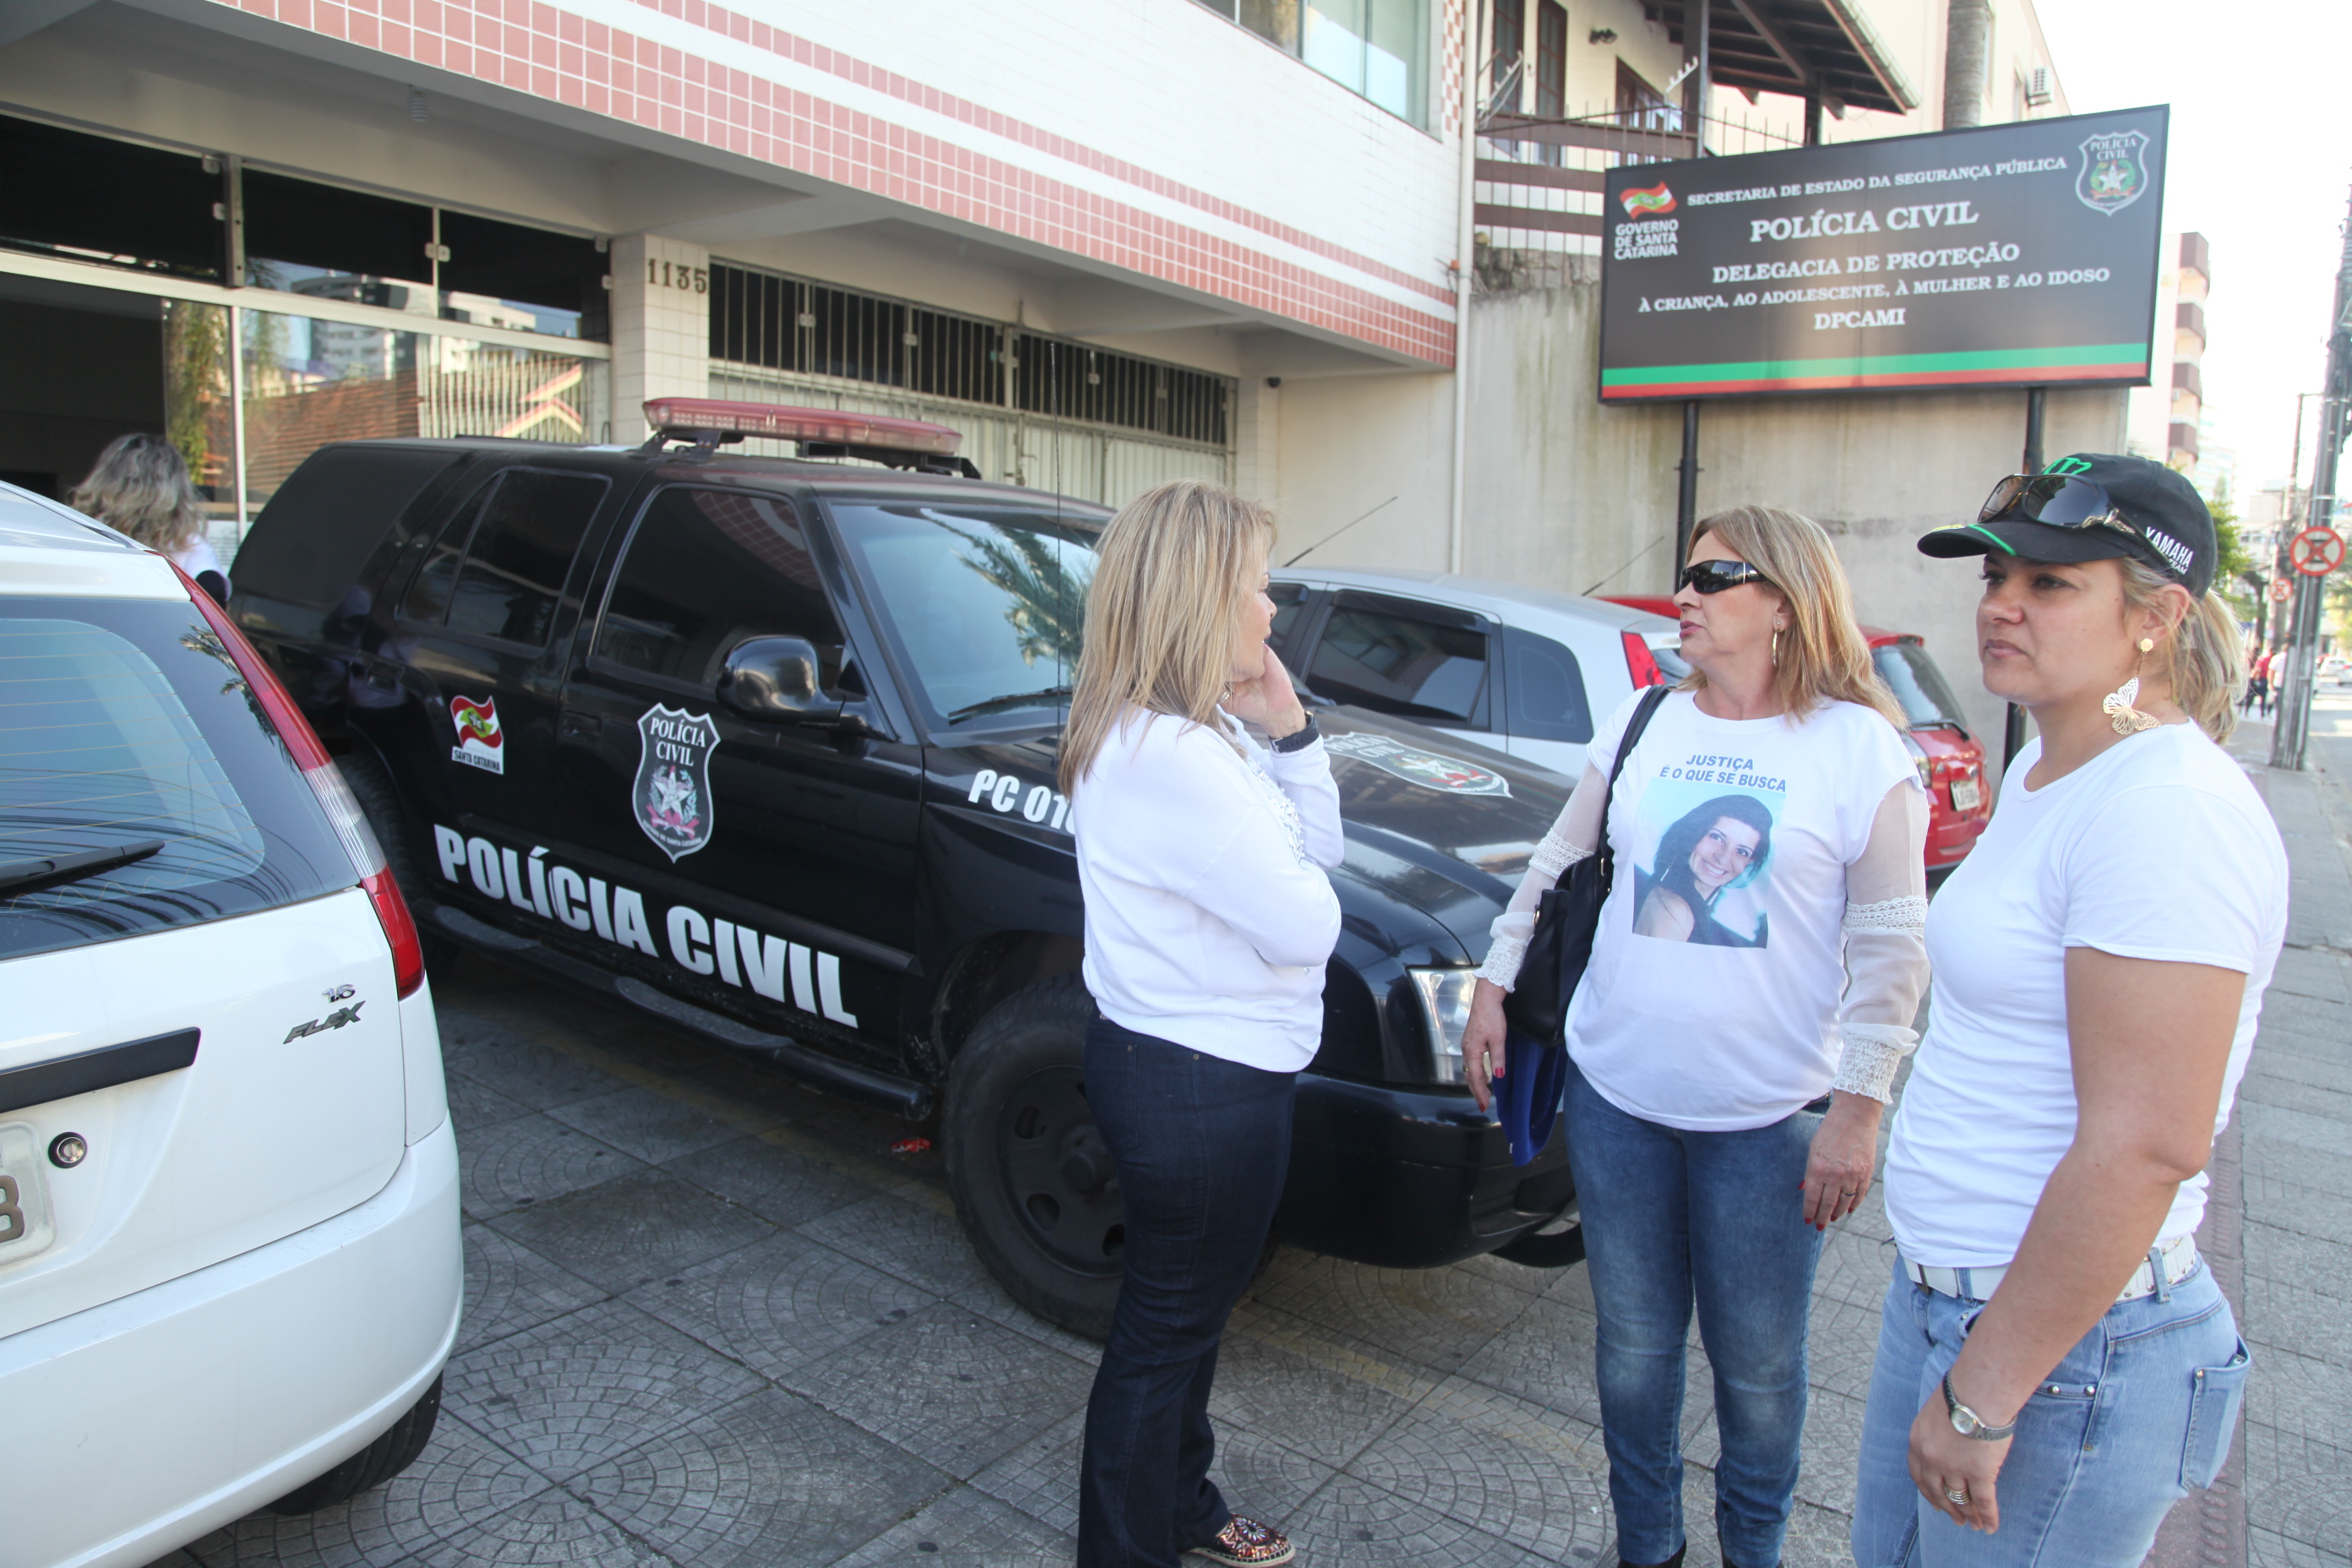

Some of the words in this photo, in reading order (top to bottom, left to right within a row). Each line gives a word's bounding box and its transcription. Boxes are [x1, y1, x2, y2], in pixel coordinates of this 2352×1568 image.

[2096, 149, 2128, 161] CIVIL
[1687, 187, 1777, 205] SECRETARIA
[1781, 184, 1801, 197] DE
[1805, 177, 1865, 194] ESTADO
[1868, 176, 1891, 188] DA
[1894, 165, 1991, 186] SEGURANÇA
[1995, 157, 2067, 176] PÚBLICA
[1615, 219, 1679, 236] GOVERNO
[1750, 209, 1880, 242] POLÍCIA
[1886, 201, 1979, 231] CIVIL
[1614, 236, 1633, 248] DE
[1635, 231, 1678, 247] SANTA
[1614, 243, 1678, 260] CATARINA
[648, 258, 707, 294] 1135
[1712, 259, 1841, 283] DELEGACIA
[1846, 255, 1880, 274] DE
[1886, 242, 2020, 270] PROTEÇÃO
[1638, 297, 1651, 313] À
[1654, 295, 1729, 311] CRIANÇA,
[1733, 292, 1757, 307] AO
[1760, 284, 1890, 305] ADOLESCENTE,
[1895, 280, 1908, 296] À
[1913, 276, 1991, 294] MULHER
[1996, 275, 2010, 288] E
[2014, 272, 2042, 287] AO
[2047, 268, 2110, 285] IDOSO
[1814, 308, 1906, 329] DPCAMI
[2146, 526, 2194, 568] YAMAHA
[2169, 558, 2188, 575] TEAM
[650, 717, 706, 748] POLÍCIA
[454, 749, 472, 763] SANTA
[474, 754, 500, 771] CATARINA
[656, 740, 694, 766] CIVIL
[1686, 754, 1753, 771] JUSTIÇA
[1659, 765, 1670, 777] É
[1672, 768, 1682, 779] O
[1685, 769, 1714, 781] QUE
[1717, 771, 1735, 784] SE
[1738, 774, 1786, 792] BUSCA
[968, 770, 1020, 813] PC
[1023, 786, 1075, 836] 01
[434, 824, 659, 958] POLÍCIA
[667, 906, 858, 1029] CIVIL
[322, 983, 356, 1003] 1.6
[283, 1000, 366, 1044] FLEX
